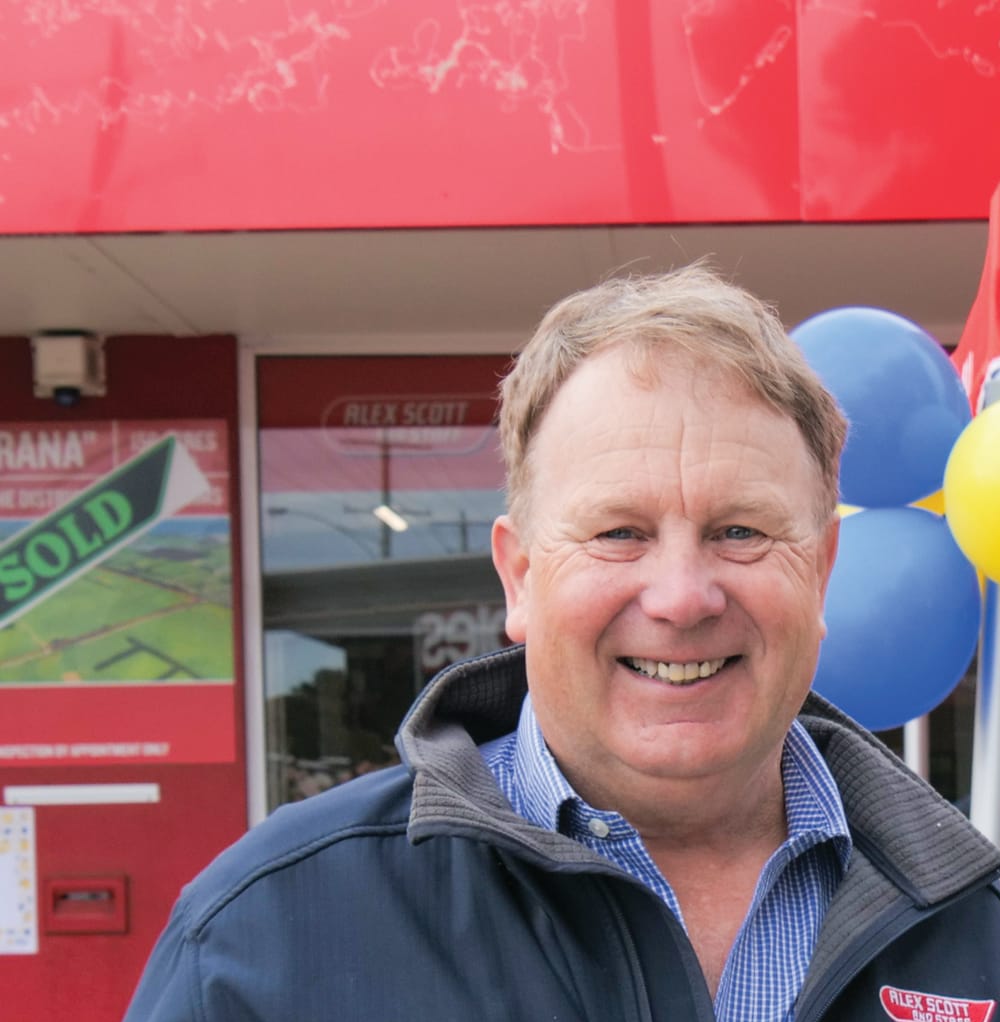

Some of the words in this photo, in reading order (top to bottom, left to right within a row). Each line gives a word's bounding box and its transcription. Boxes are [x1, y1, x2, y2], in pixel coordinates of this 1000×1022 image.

[343, 402, 396, 425] ALEX
[402, 401, 468, 425] SCOTT
[0, 490, 133, 600] SOLD
[888, 989, 923, 1011] ALEX
[925, 997, 969, 1016] SCOTT
